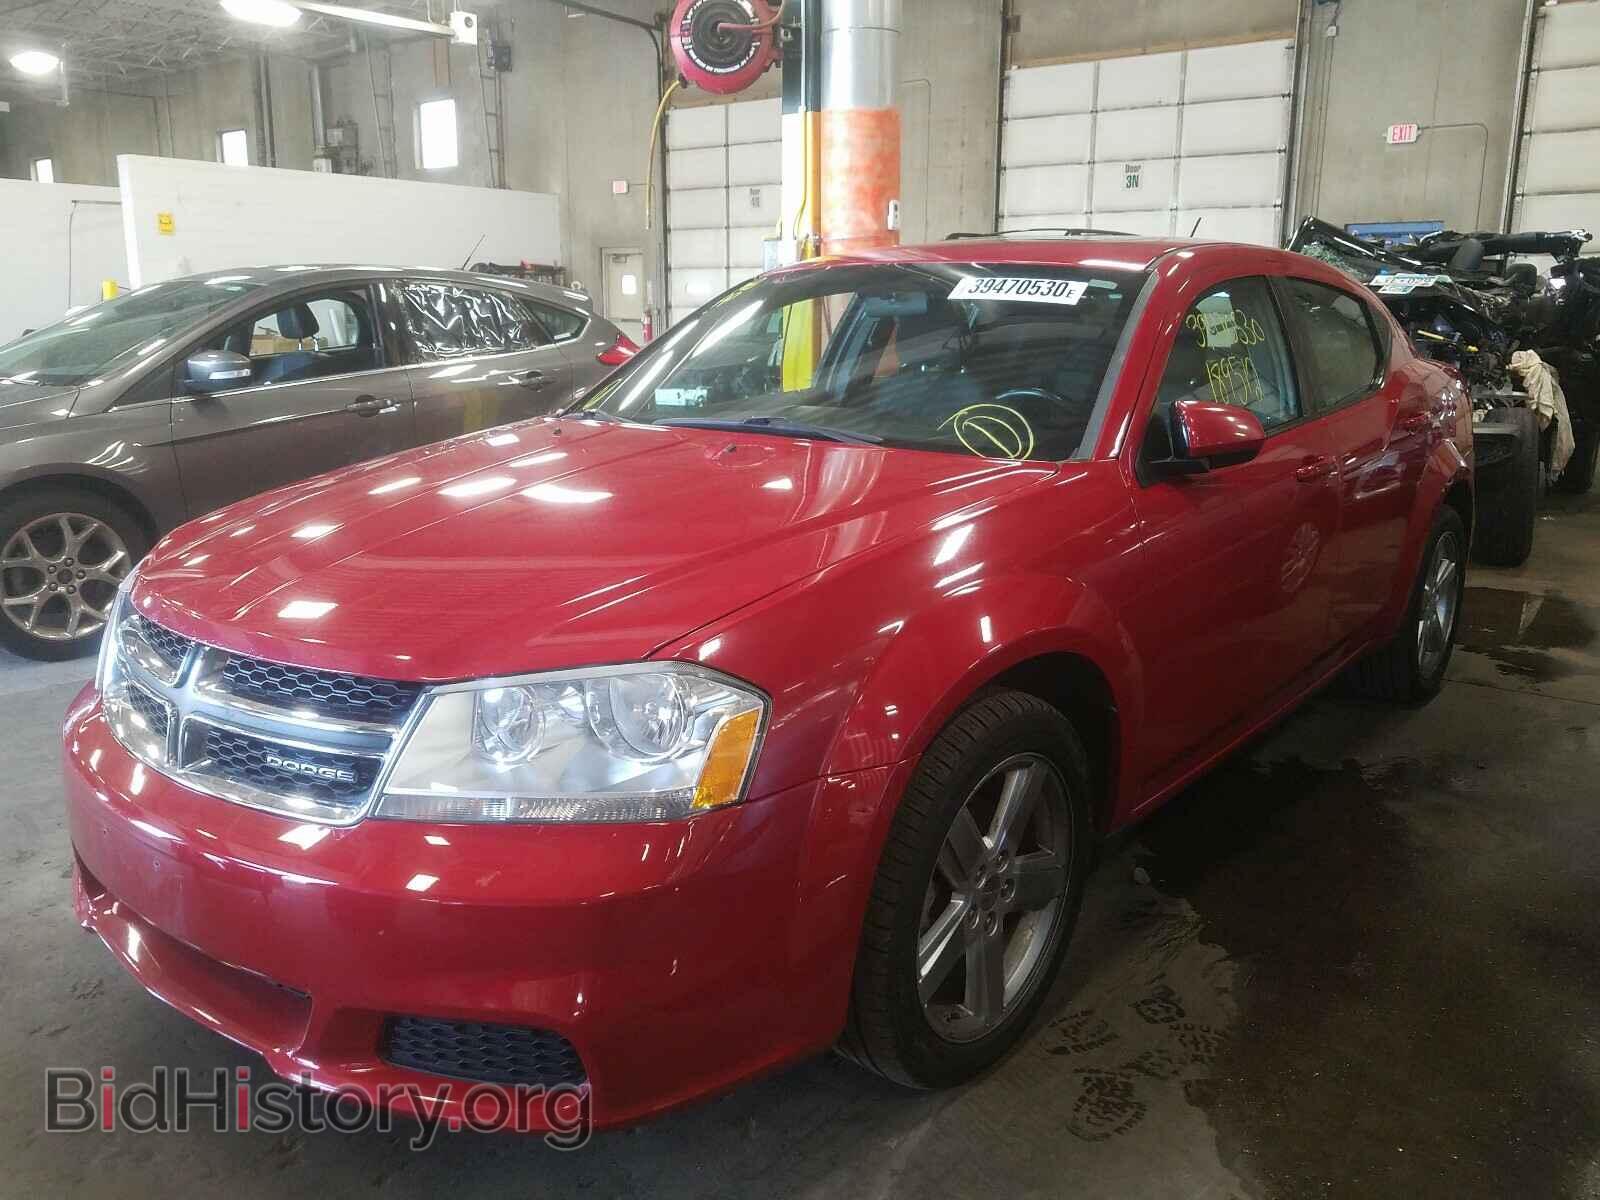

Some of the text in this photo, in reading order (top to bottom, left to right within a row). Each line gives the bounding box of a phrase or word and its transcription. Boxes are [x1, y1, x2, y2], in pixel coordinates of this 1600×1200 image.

[1392, 125, 1414, 141] EXIT
[1126, 175, 1139, 188] 3N
[266, 756, 354, 782] DODGE
